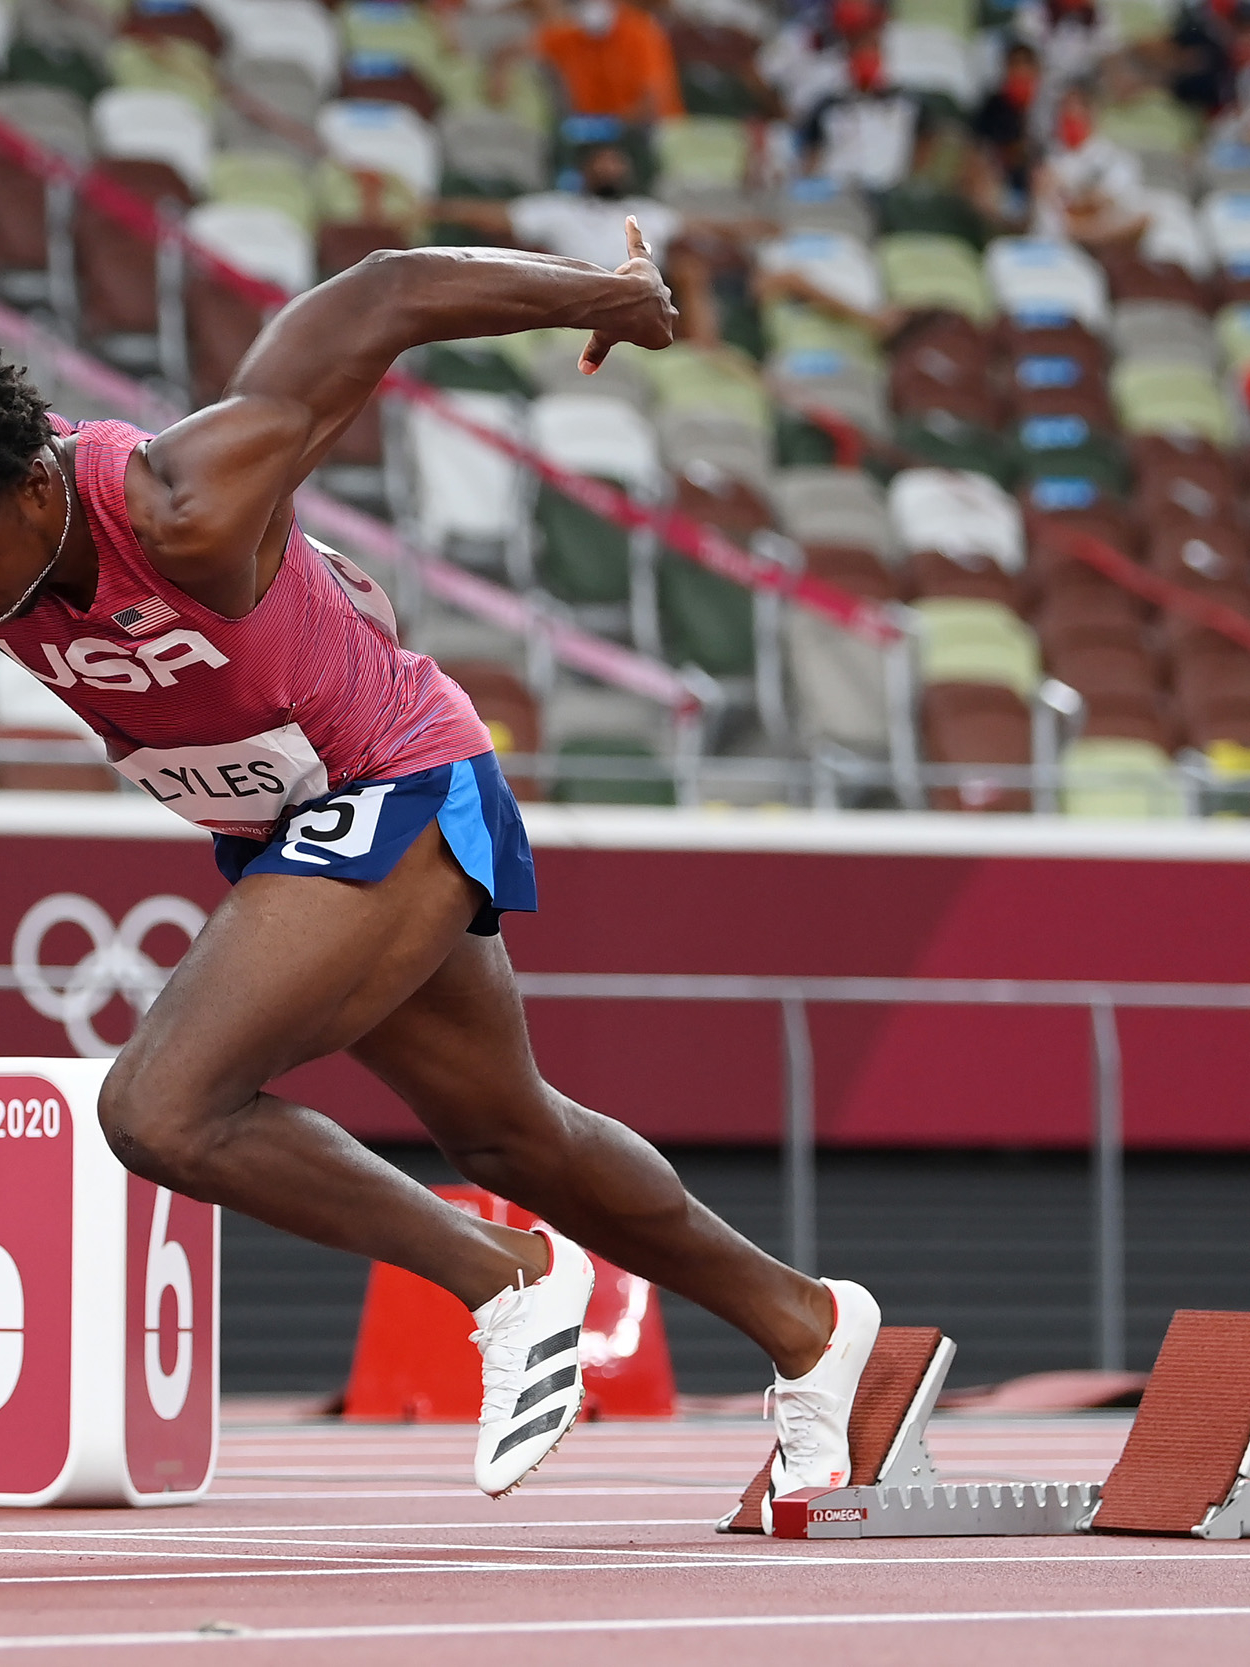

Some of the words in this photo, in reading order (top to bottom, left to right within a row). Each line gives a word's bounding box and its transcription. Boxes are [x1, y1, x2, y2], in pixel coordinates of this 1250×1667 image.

[138, 760, 285, 802] LYLES
[300, 789, 364, 842] 5
[144, 1186, 194, 1421] 6
[824, 1509, 862, 1522] OMEGA
